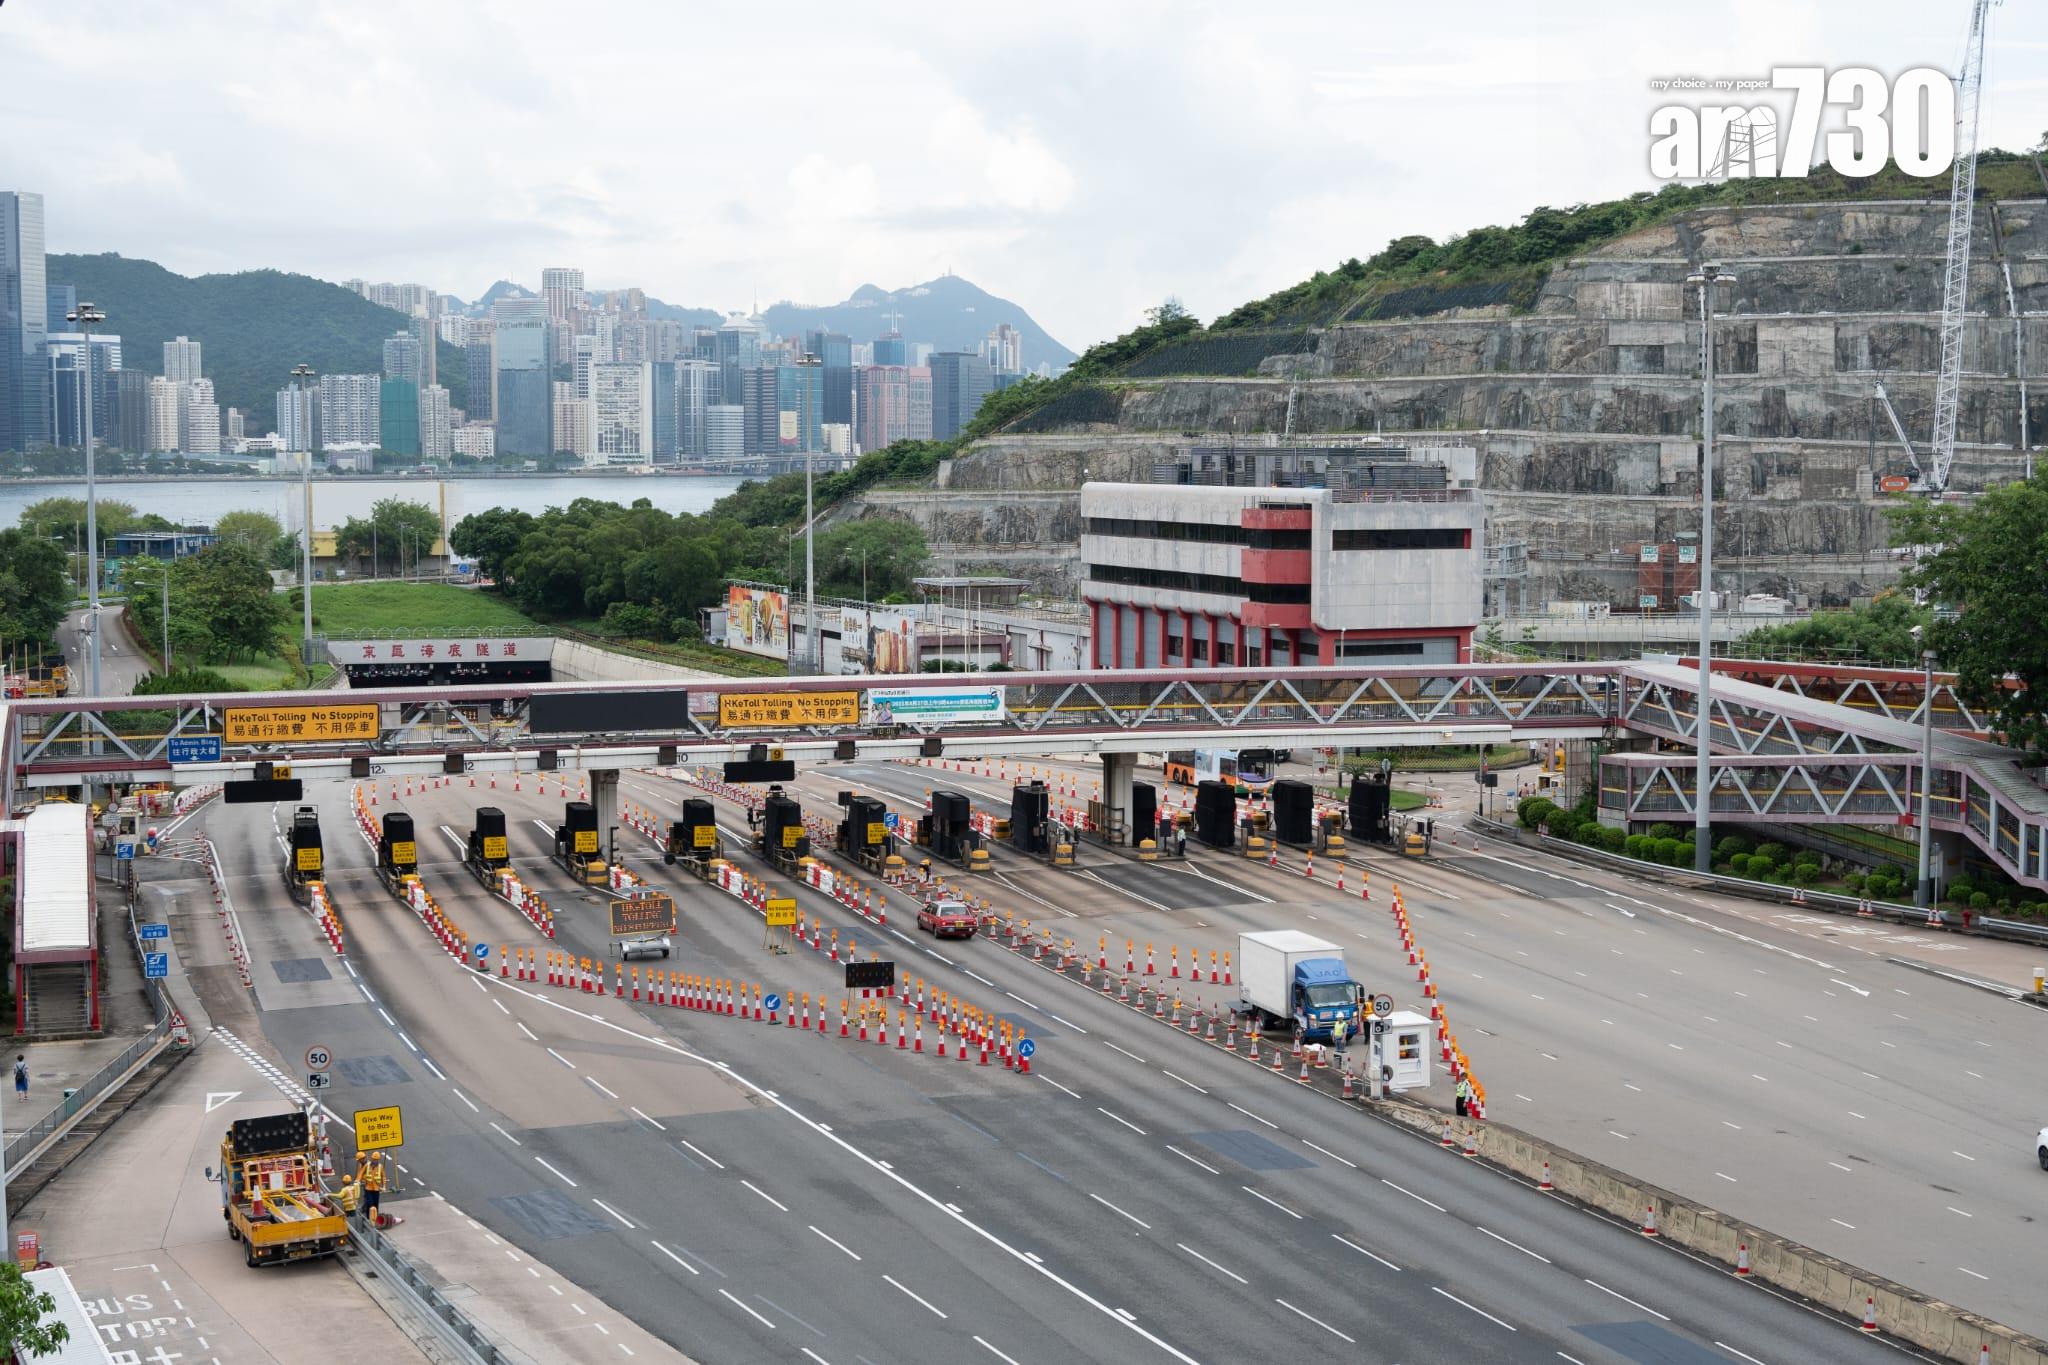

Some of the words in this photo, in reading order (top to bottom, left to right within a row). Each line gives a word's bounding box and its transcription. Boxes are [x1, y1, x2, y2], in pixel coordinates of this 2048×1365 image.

[362, 642, 518, 659] 東區海底隧道
[724, 699, 760, 708] HKeToll
[762, 699, 793, 708] Tolling
[798, 698, 811, 706] No
[813, 697, 854, 707] Stopping
[230, 713, 270, 723] HKeToll
[273, 712, 306, 723] Tolling
[312, 711, 327, 720] No
[329, 710, 374, 721] Stopping
[727, 709, 791, 721] 易通行繳費
[801, 707, 852, 720] 不用停車
[233, 723, 304, 737] 易通行繳費
[316, 721, 371, 735] 不用停車
[677, 753, 689, 763] 10
[773, 749, 781, 759] 9
[464, 761, 475, 771] 12
[557, 758, 567, 768] 11
[273, 767, 289, 778] 14
[1375, 1001, 1390, 1011] 50
[310, 1053, 328, 1064] 50
[361, 1116, 378, 1124] Give
[361, 1131, 398, 1143] 請讓巴士
[80, 1294, 154, 1318] BUS
